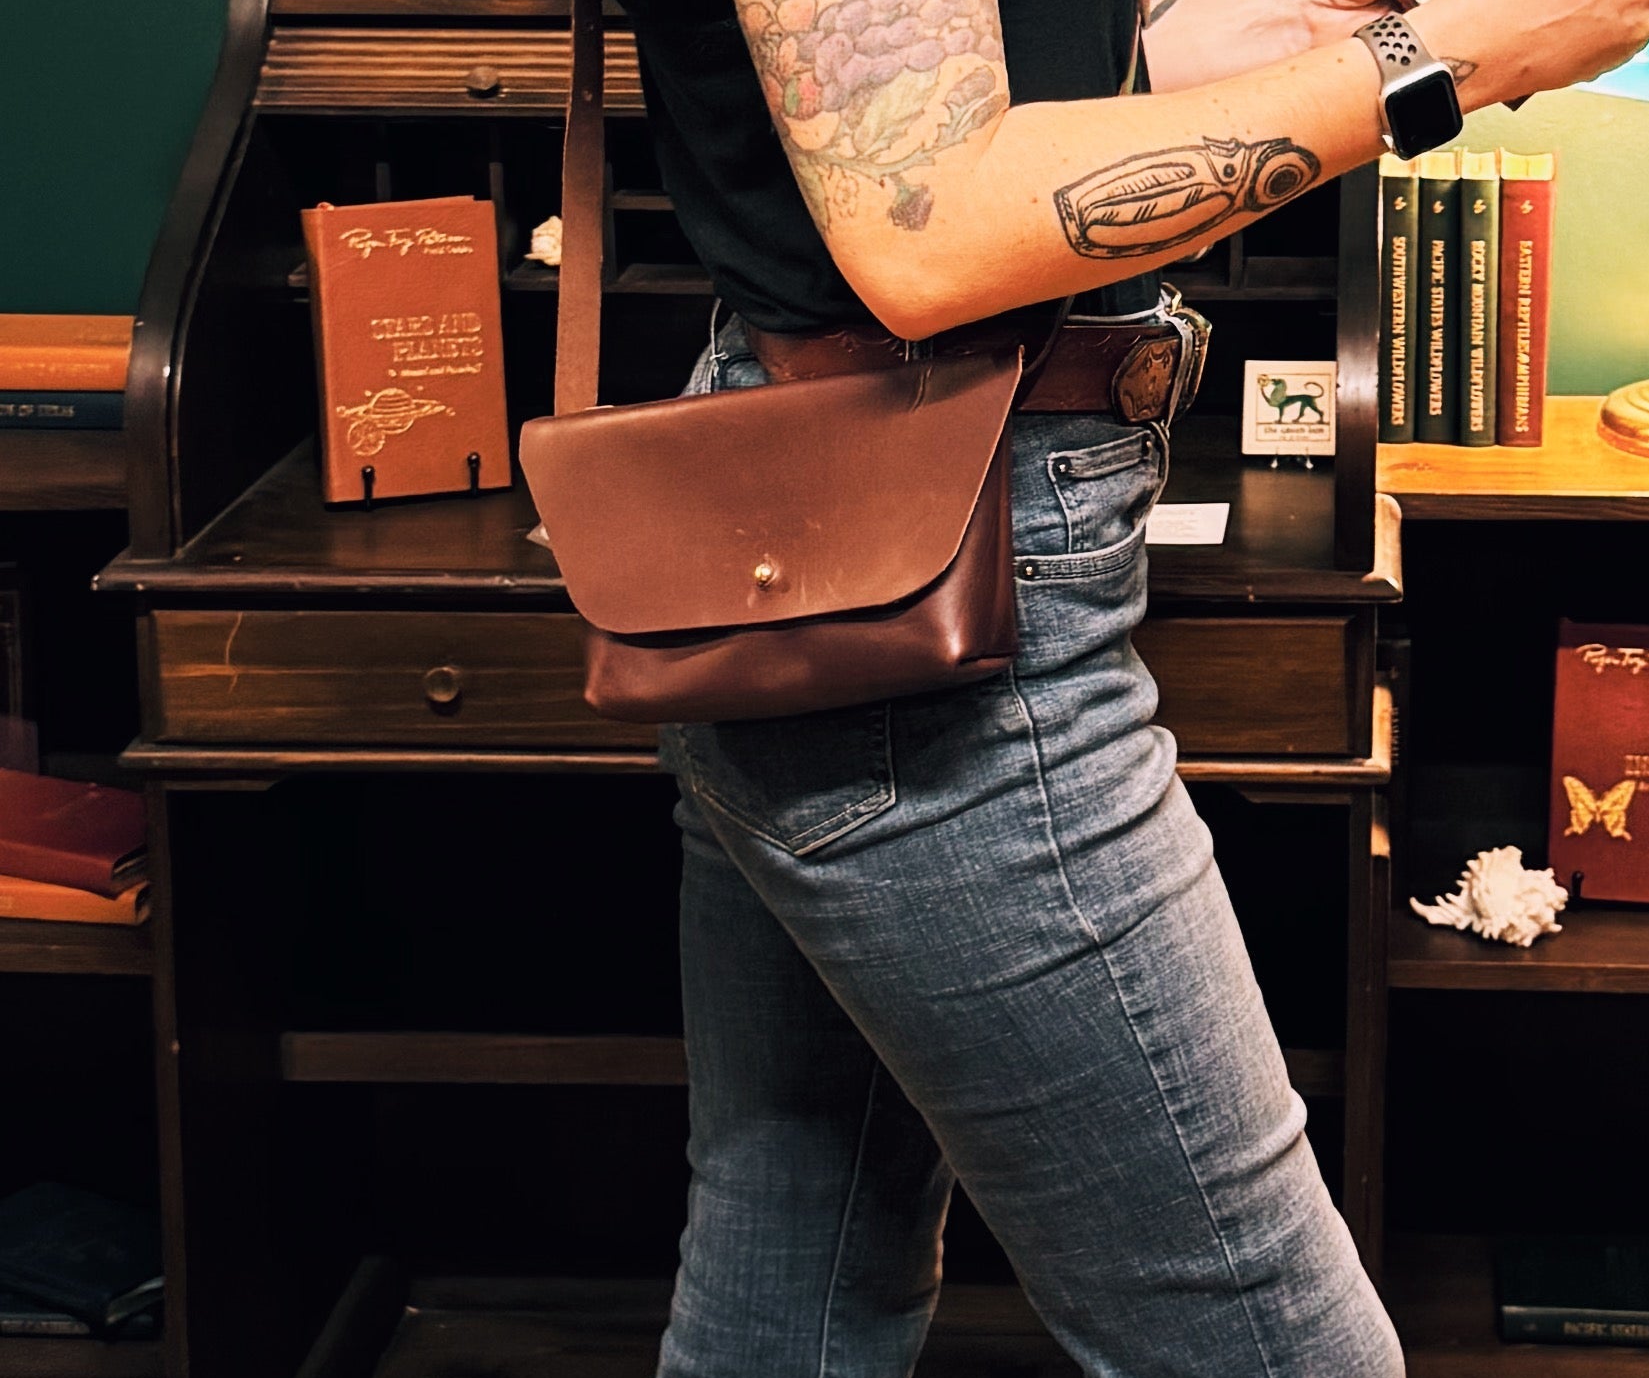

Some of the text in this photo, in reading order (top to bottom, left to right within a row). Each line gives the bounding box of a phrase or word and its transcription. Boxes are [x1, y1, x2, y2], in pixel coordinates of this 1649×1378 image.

[438, 311, 482, 335] AND
[1390, 235, 1406, 426] SOUTHWESTERN WILDFLOWERS
[1429, 239, 1445, 416] PACIFIC STATES WILDFLOWERS
[1469, 239, 1486, 432] ROCKY MOUNTAIN WILDFLOWERS
[1518, 240, 1534, 294] EASTERN
